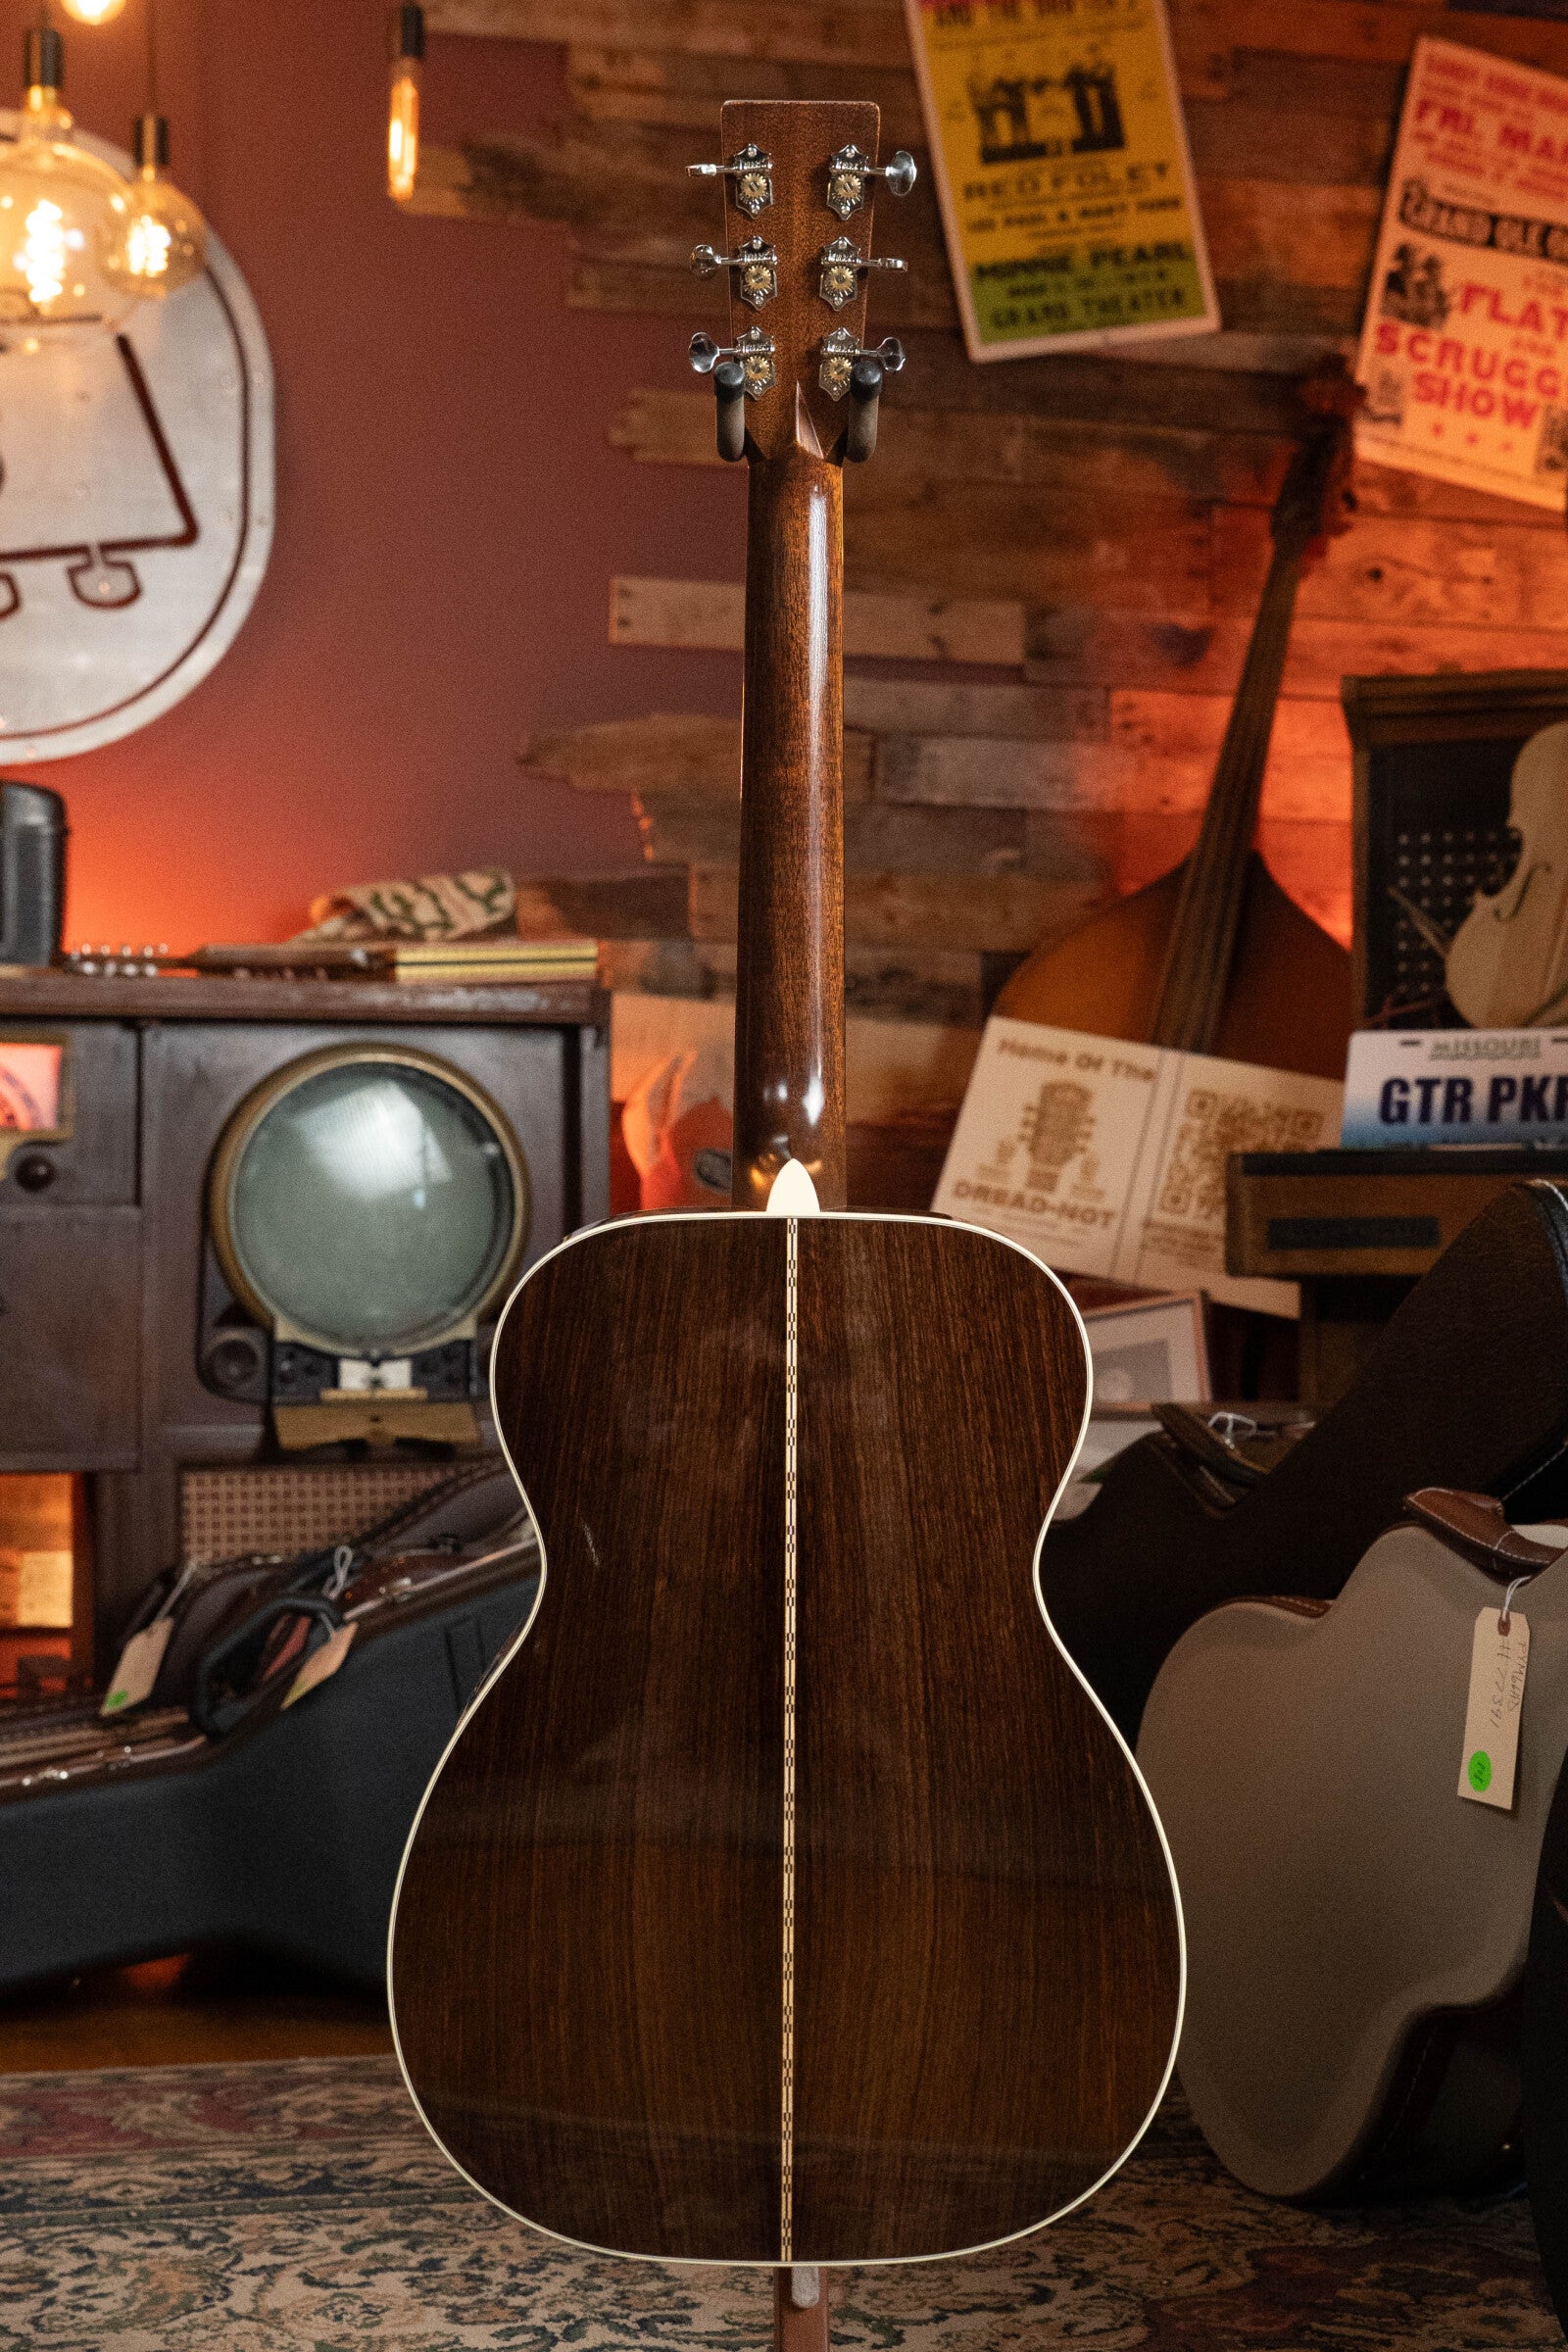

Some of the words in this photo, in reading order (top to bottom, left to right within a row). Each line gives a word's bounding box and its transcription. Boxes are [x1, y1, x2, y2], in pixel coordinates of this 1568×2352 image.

[1499, 125, 1568, 167] MA
[1413, 370, 1539, 430] SHOW
[1431, 1038, 1542, 1061] MISSOURI
[1380, 1076, 1474, 1125] GTR
[952, 1179, 1115, 1231] DREAD-NOT
